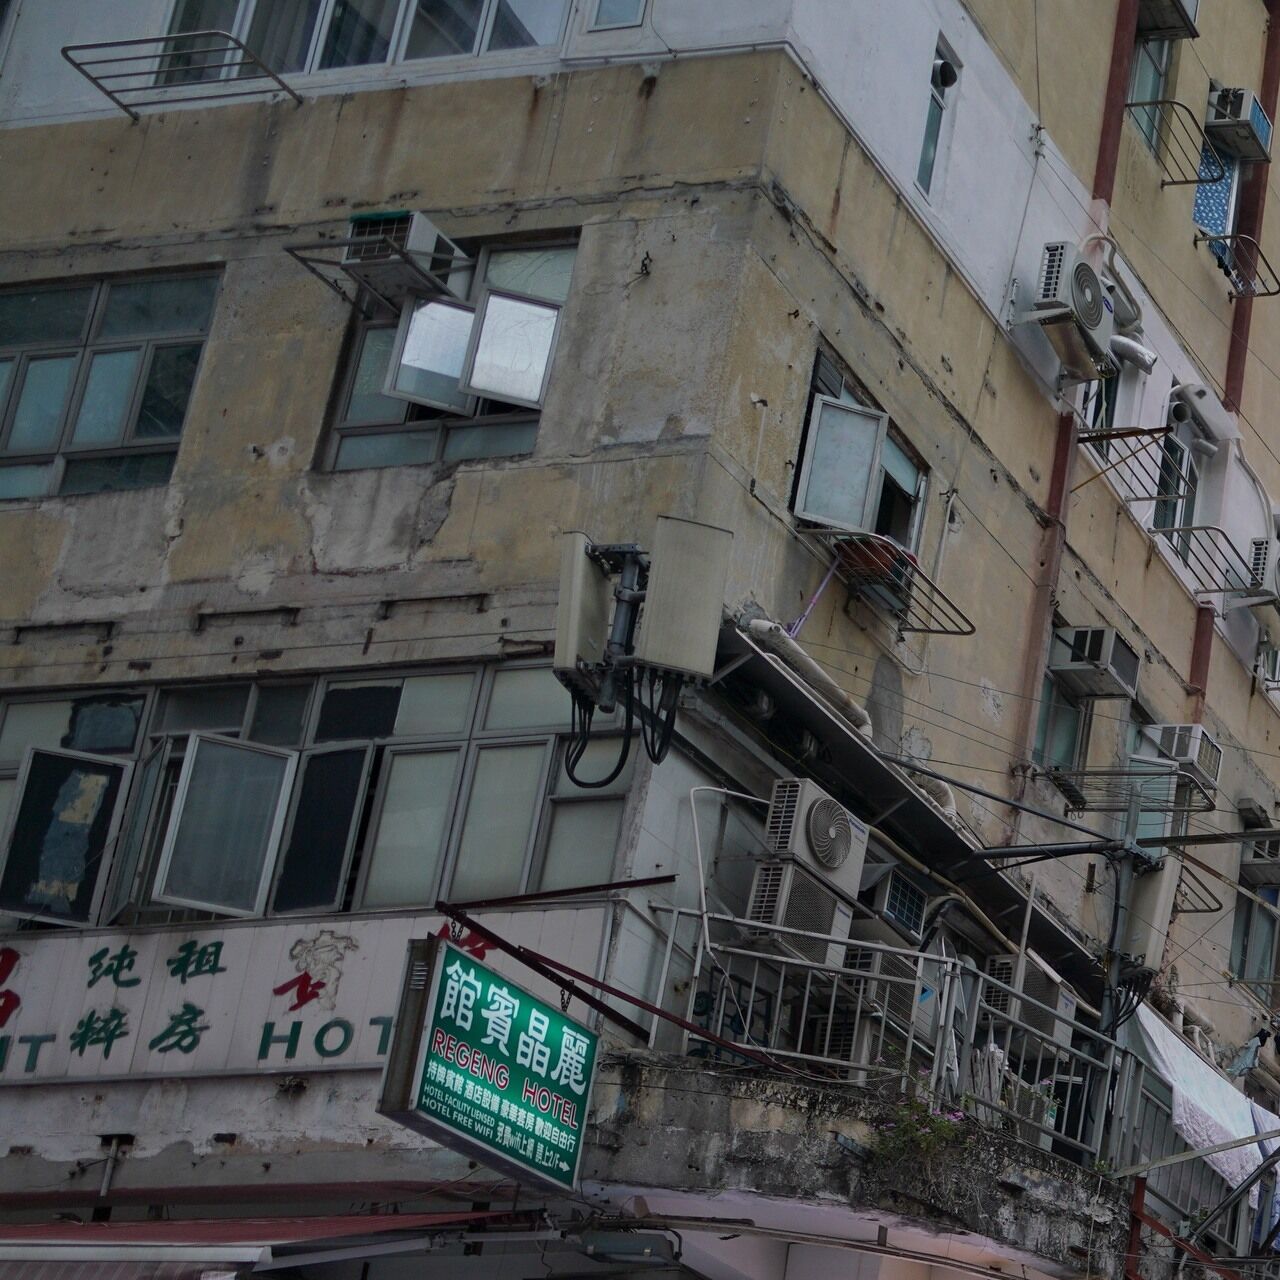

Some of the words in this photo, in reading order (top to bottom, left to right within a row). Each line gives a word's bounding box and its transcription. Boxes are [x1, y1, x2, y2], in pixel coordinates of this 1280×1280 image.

[424, 1083, 445, 1104] HOTEL
[444, 1094, 472, 1118] FACILITY
[432, 1028, 510, 1090] REGENG
[521, 1078, 578, 1129] HOTEL
[421, 1094, 451, 1118] HOTEL
[452, 1110, 473, 1130] FREE
[474, 1121, 494, 1140] WIFI
